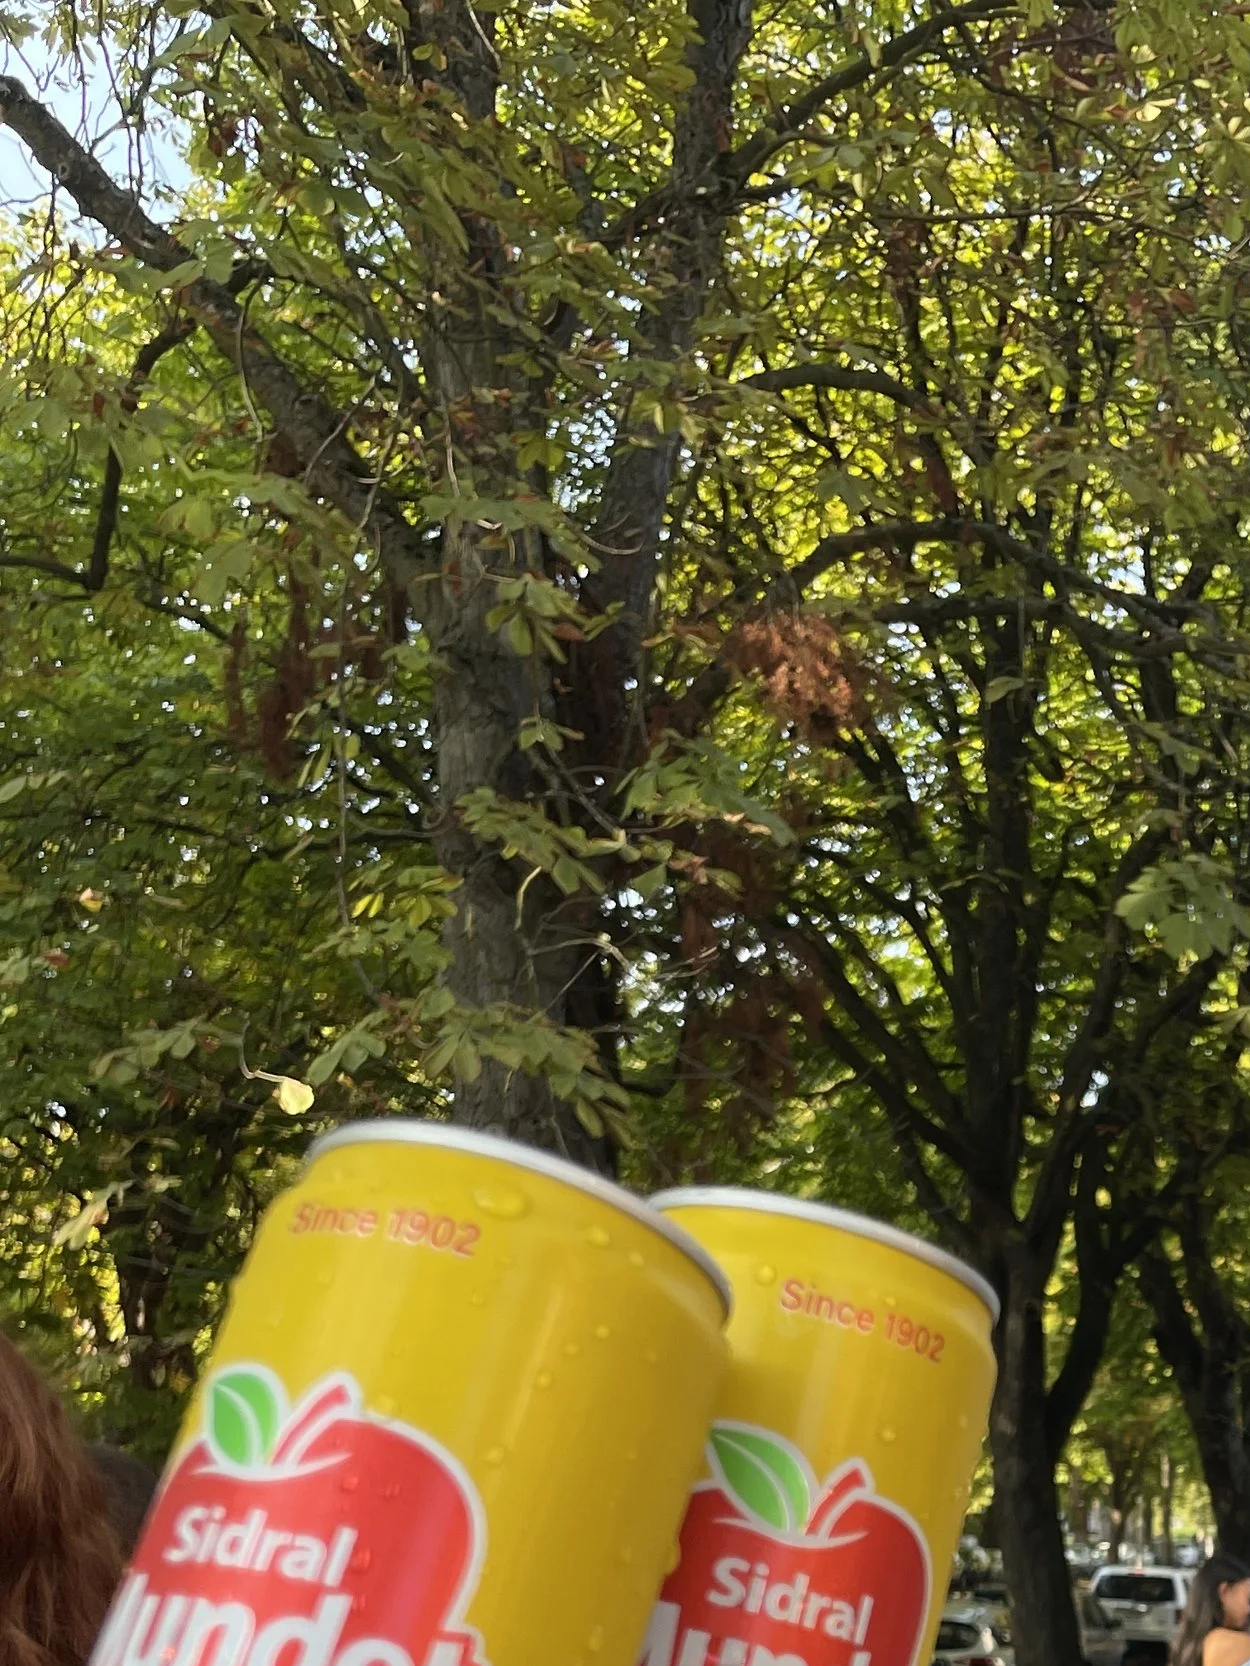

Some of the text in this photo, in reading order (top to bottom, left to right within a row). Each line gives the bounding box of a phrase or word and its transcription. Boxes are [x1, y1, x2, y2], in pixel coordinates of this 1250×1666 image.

[289, 1202, 481, 1257] Since 1902
[780, 1279, 946, 1364] Since 1902
[163, 1505, 359, 1587] Sidral
[706, 1556, 874, 1646] Sidral
